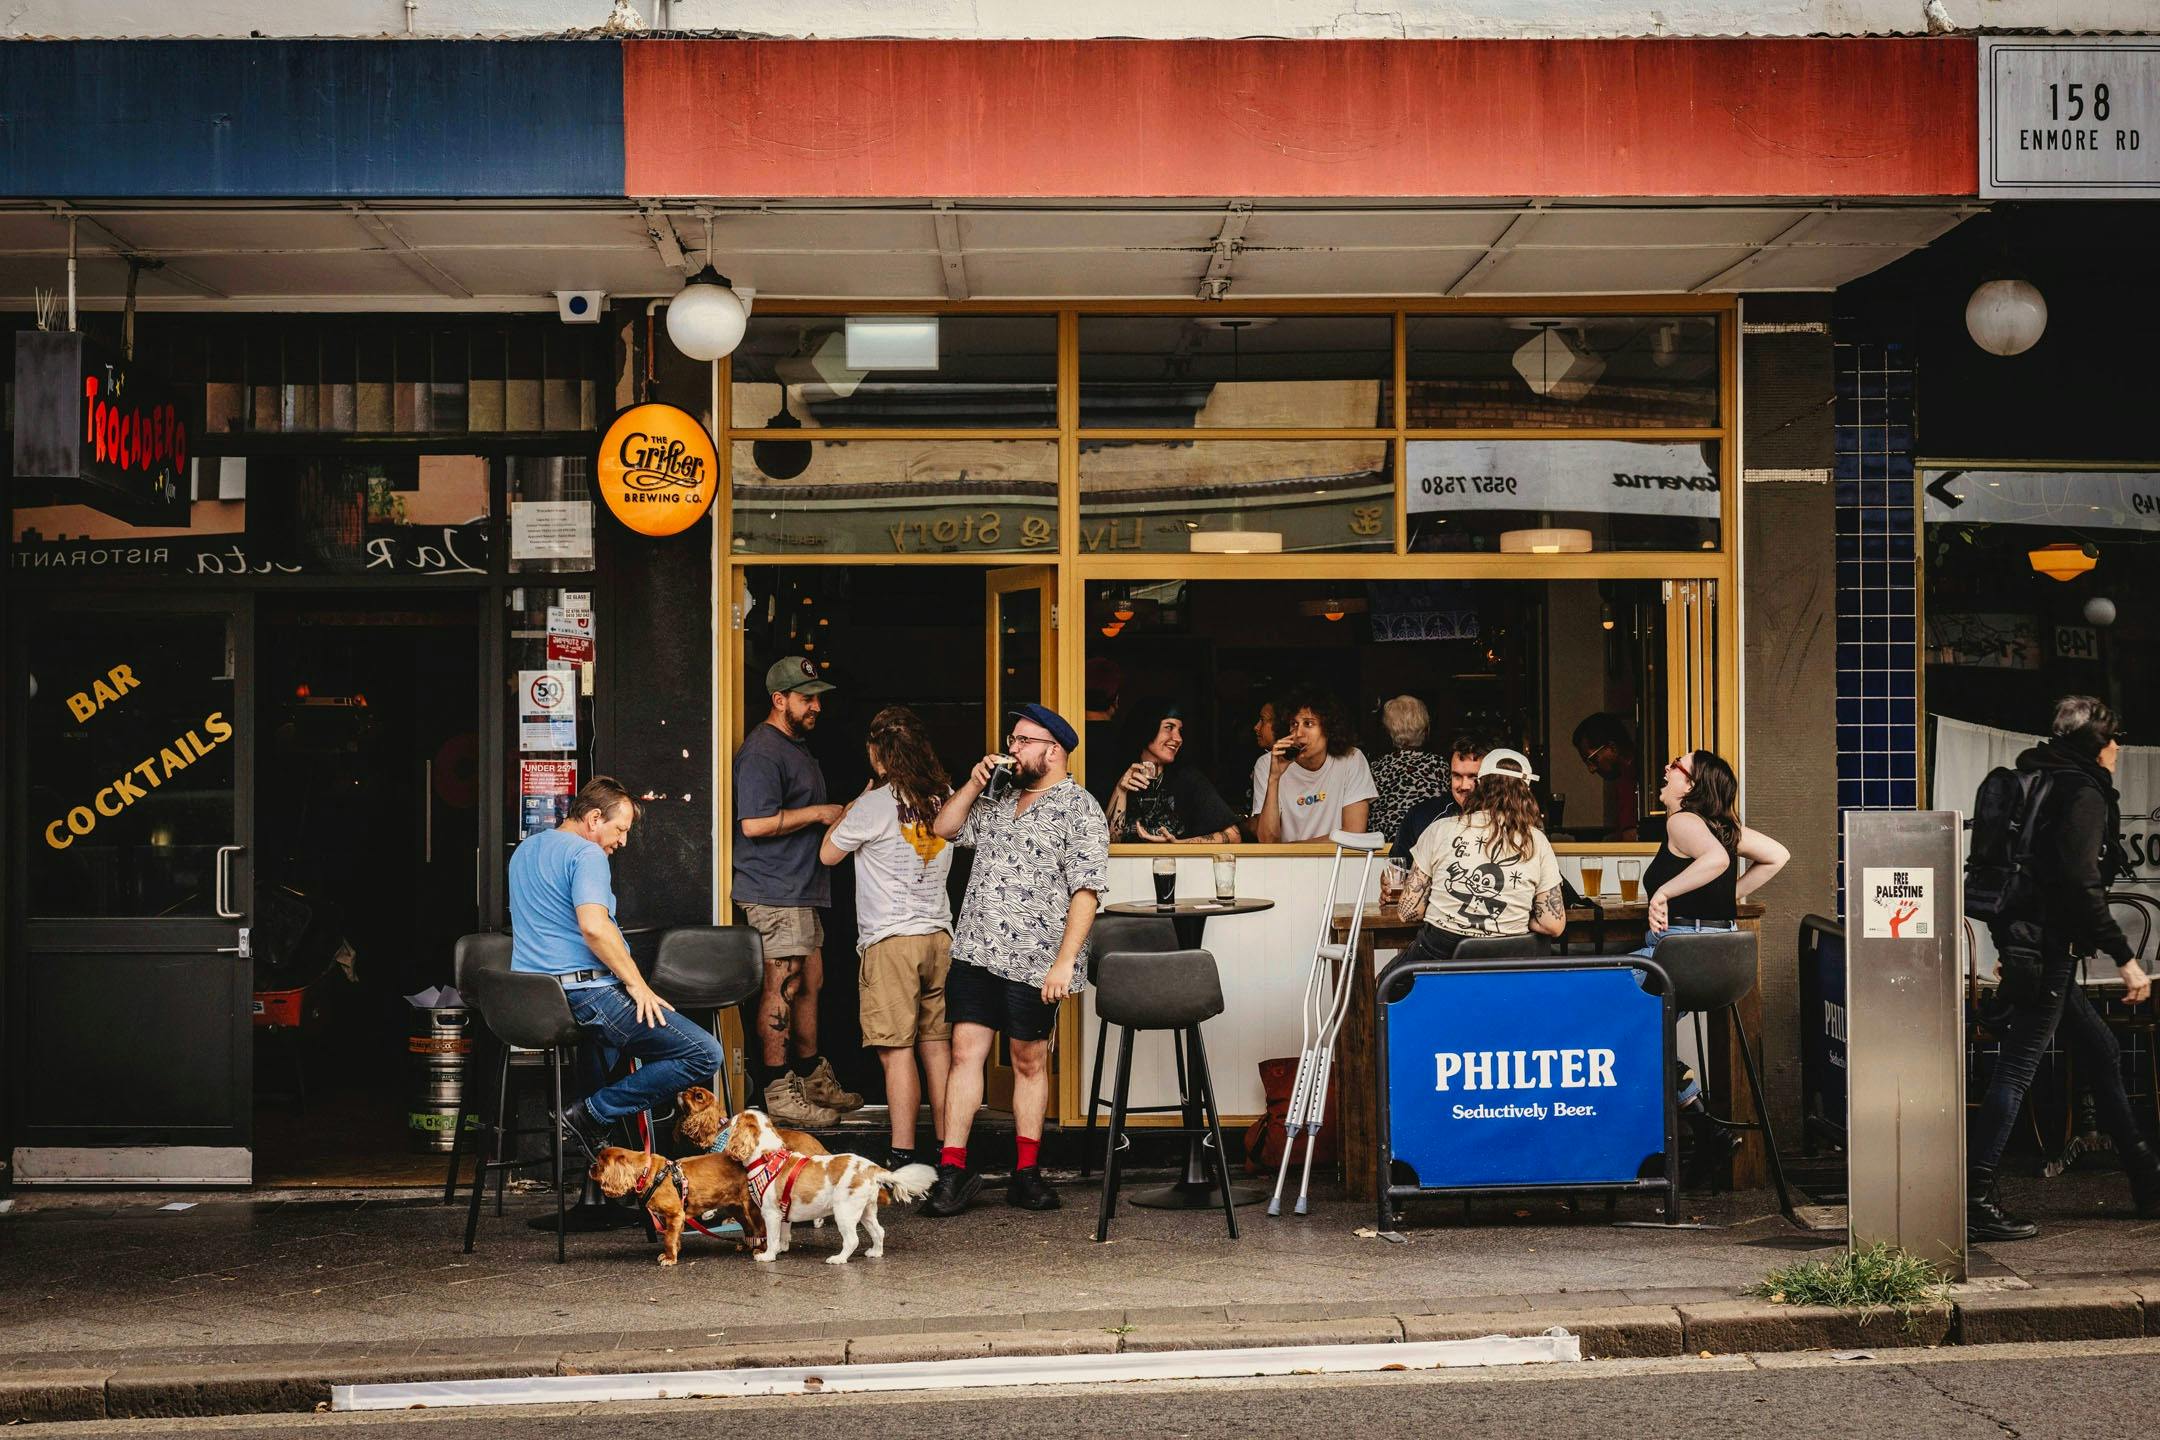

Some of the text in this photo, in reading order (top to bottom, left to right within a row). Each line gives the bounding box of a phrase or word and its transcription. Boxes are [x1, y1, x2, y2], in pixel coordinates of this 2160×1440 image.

[2050, 83, 2110, 121] 158
[2020, 129, 2140, 150] ENMORE RD
[86, 376, 186, 475] TROCADERO
[651, 436, 667, 444] THE
[619, 432, 705, 482] Grifter
[624, 493, 702, 503] BREWING CO.
[66, 664, 141, 723] BAR
[537, 682, 559, 698] 50
[525, 764, 572, 772] UNDER 25?
[45, 712, 232, 849] COCKTAILS
[1893, 872, 1909, 885] FREE
[1876, 885, 1924, 898] PALESTINE
[1824, 999, 1847, 1043] PHIL
[1434, 1048, 1618, 1092] PHILTER
[1452, 1102, 1598, 1121] Seductively Beer.
